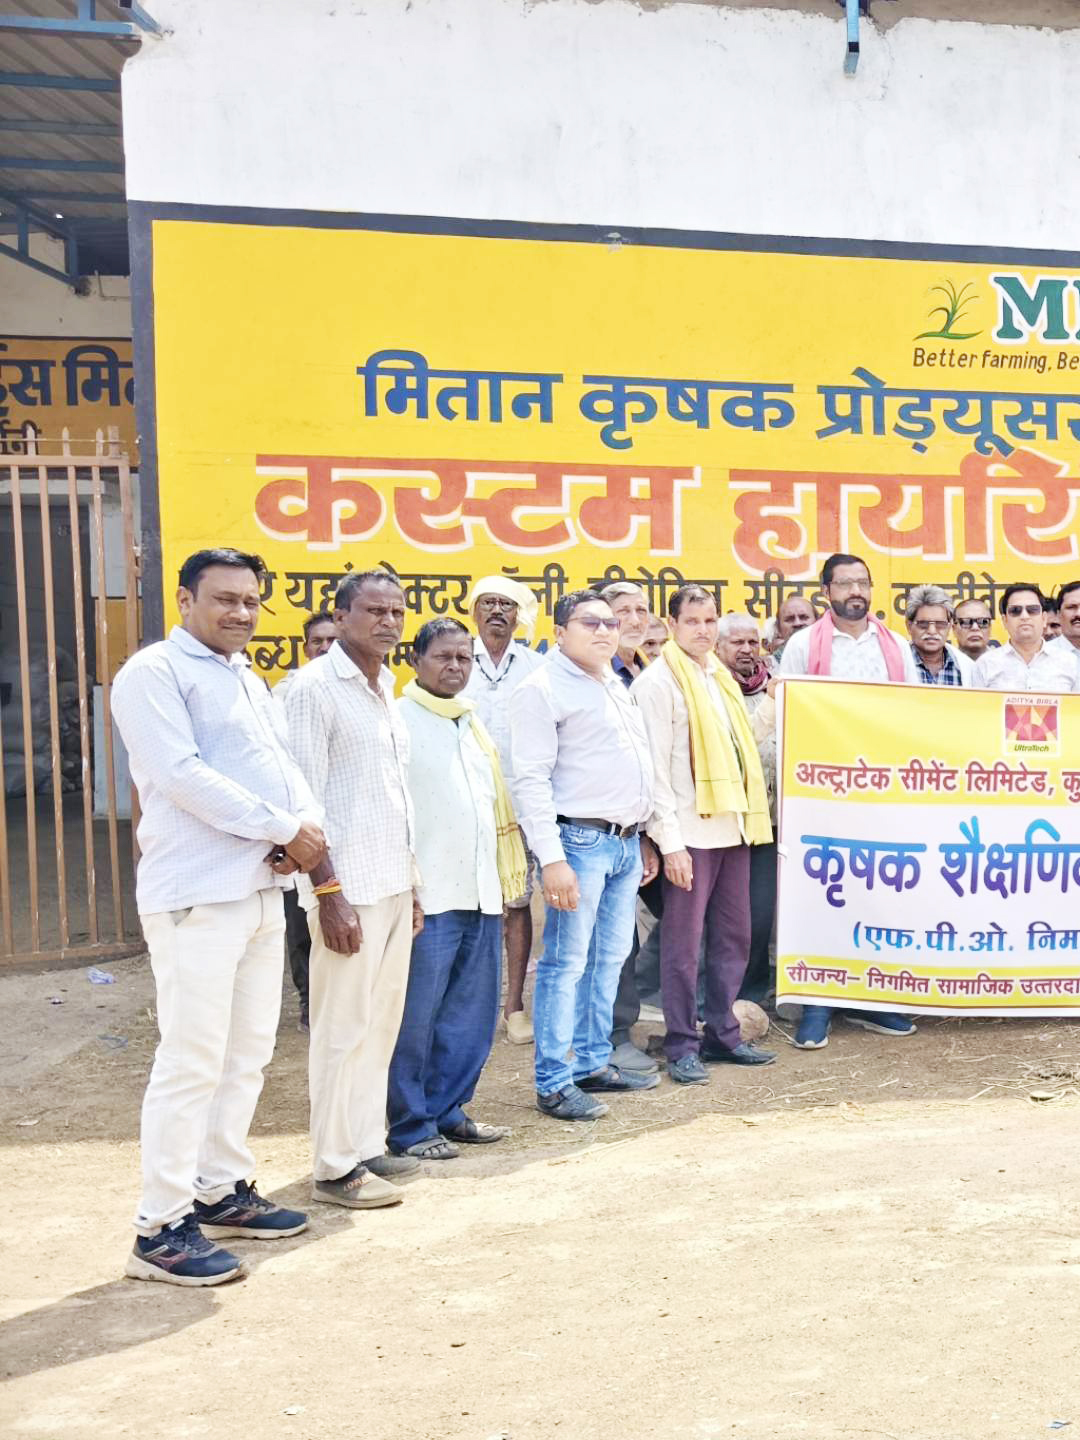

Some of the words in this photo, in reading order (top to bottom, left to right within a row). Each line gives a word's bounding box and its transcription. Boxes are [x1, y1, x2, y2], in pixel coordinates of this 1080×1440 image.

[62, 344, 134, 407] मि
[913, 347, 977, 368] Better
[356, 349, 564, 424] मितान
[579, 374, 795, 449] कृषक
[254, 453, 702, 556] कस्टम
[1013, 743, 1050, 753] UltraTech
[796, 758, 890, 795] अल्ट्राटेक
[900, 758, 957, 793] सीमेंट
[966, 761, 1054, 797] लिमिटेड,
[800, 833, 927, 908] कृषक
[867, 968, 930, 995] निगमित
[936, 973, 1014, 996] सामाजिक
